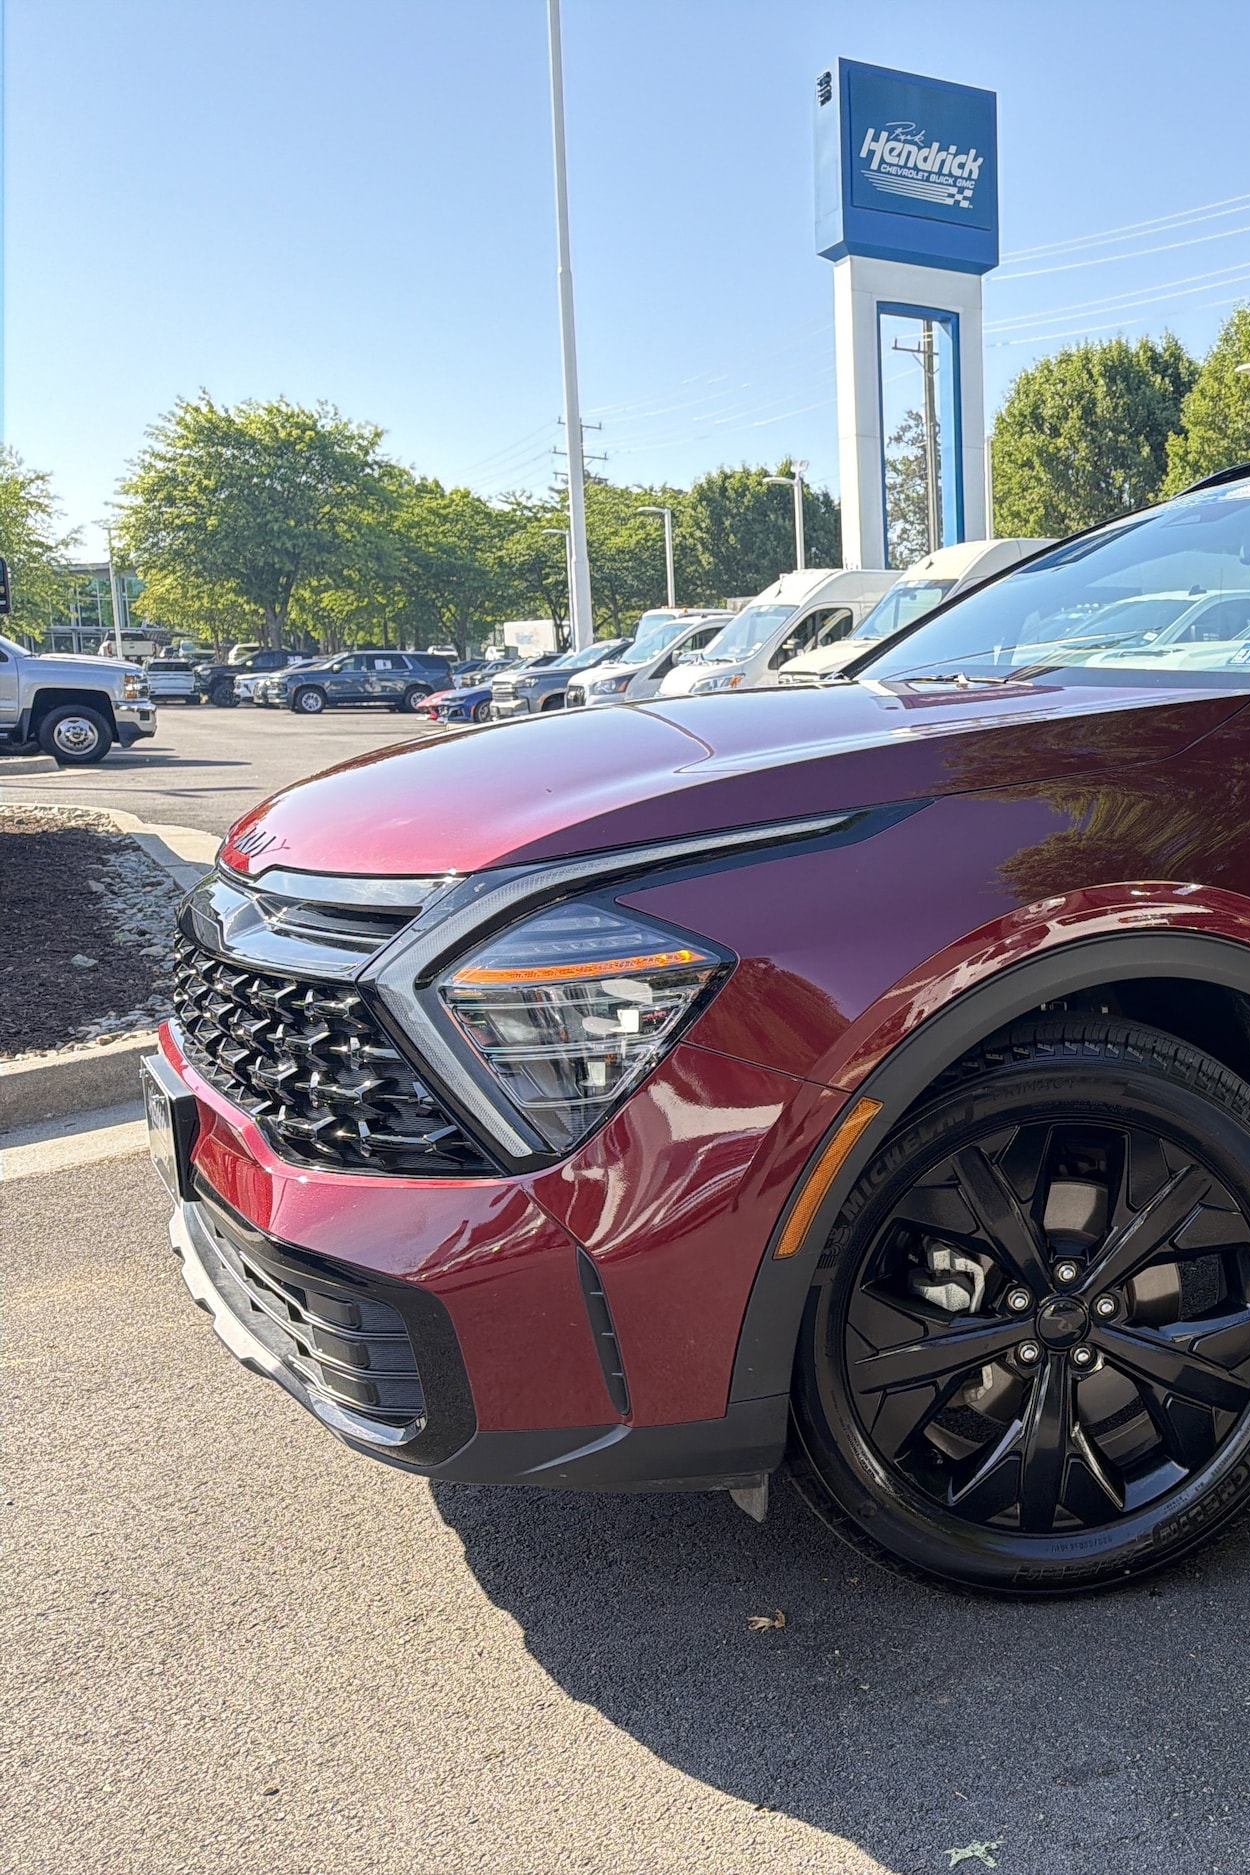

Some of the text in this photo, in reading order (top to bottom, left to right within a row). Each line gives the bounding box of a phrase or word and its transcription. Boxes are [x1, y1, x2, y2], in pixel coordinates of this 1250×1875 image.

[860, 128, 984, 179] Hendrick
[881, 164, 976, 189] CHEVROLET BUICK GMC
[841, 1105, 969, 1222] MICHELIN
